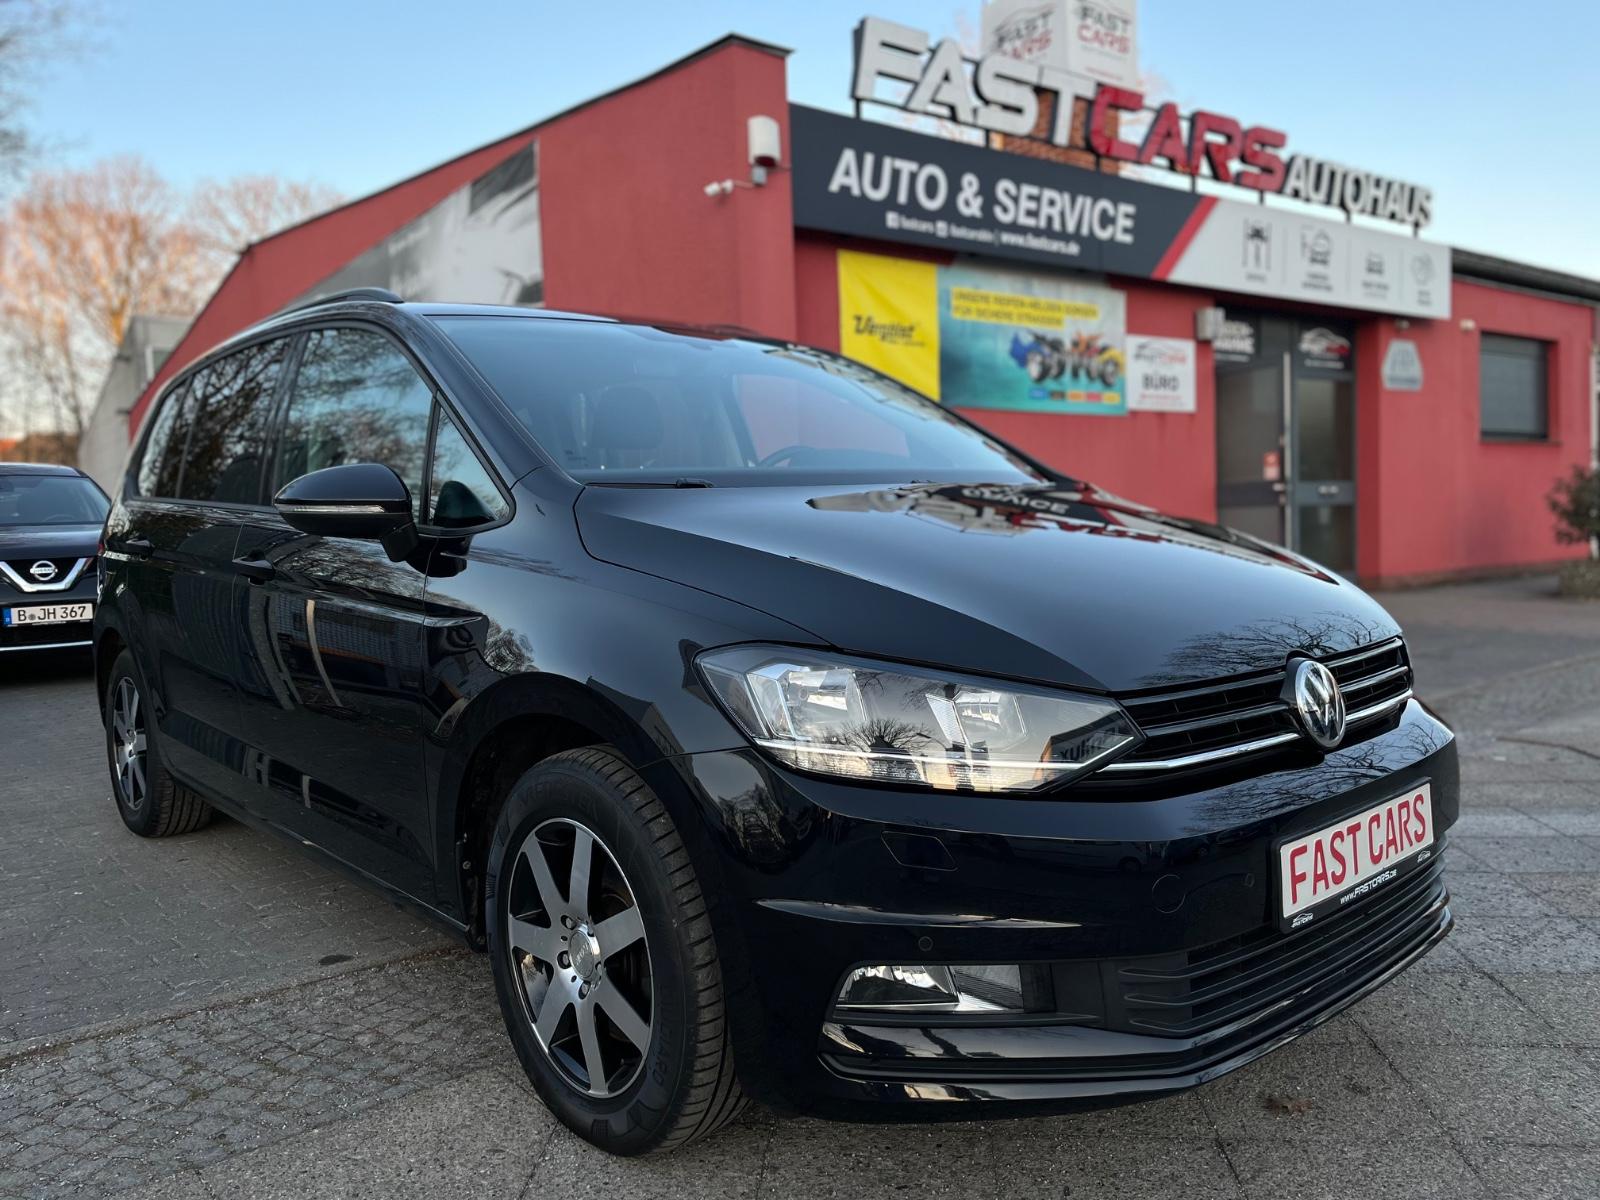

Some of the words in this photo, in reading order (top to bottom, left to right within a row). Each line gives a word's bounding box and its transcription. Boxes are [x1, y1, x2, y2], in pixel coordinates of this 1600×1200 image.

[1078, 23, 1131, 53] CARS
[828, 147, 948, 211] AUTO
[956, 171, 984, 218] &
[993, 178, 1137, 244] SERVICE
[1283, 155, 1433, 229] AUTOHAUS
[1142, 370, 1179, 392] BÜRO
[17, 609, 27, 622] B
[37, 607, 57, 620] JH
[60, 605, 87, 619] 367
[1289, 820, 1362, 905] FAST
[1367, 793, 1427, 866] CARS
